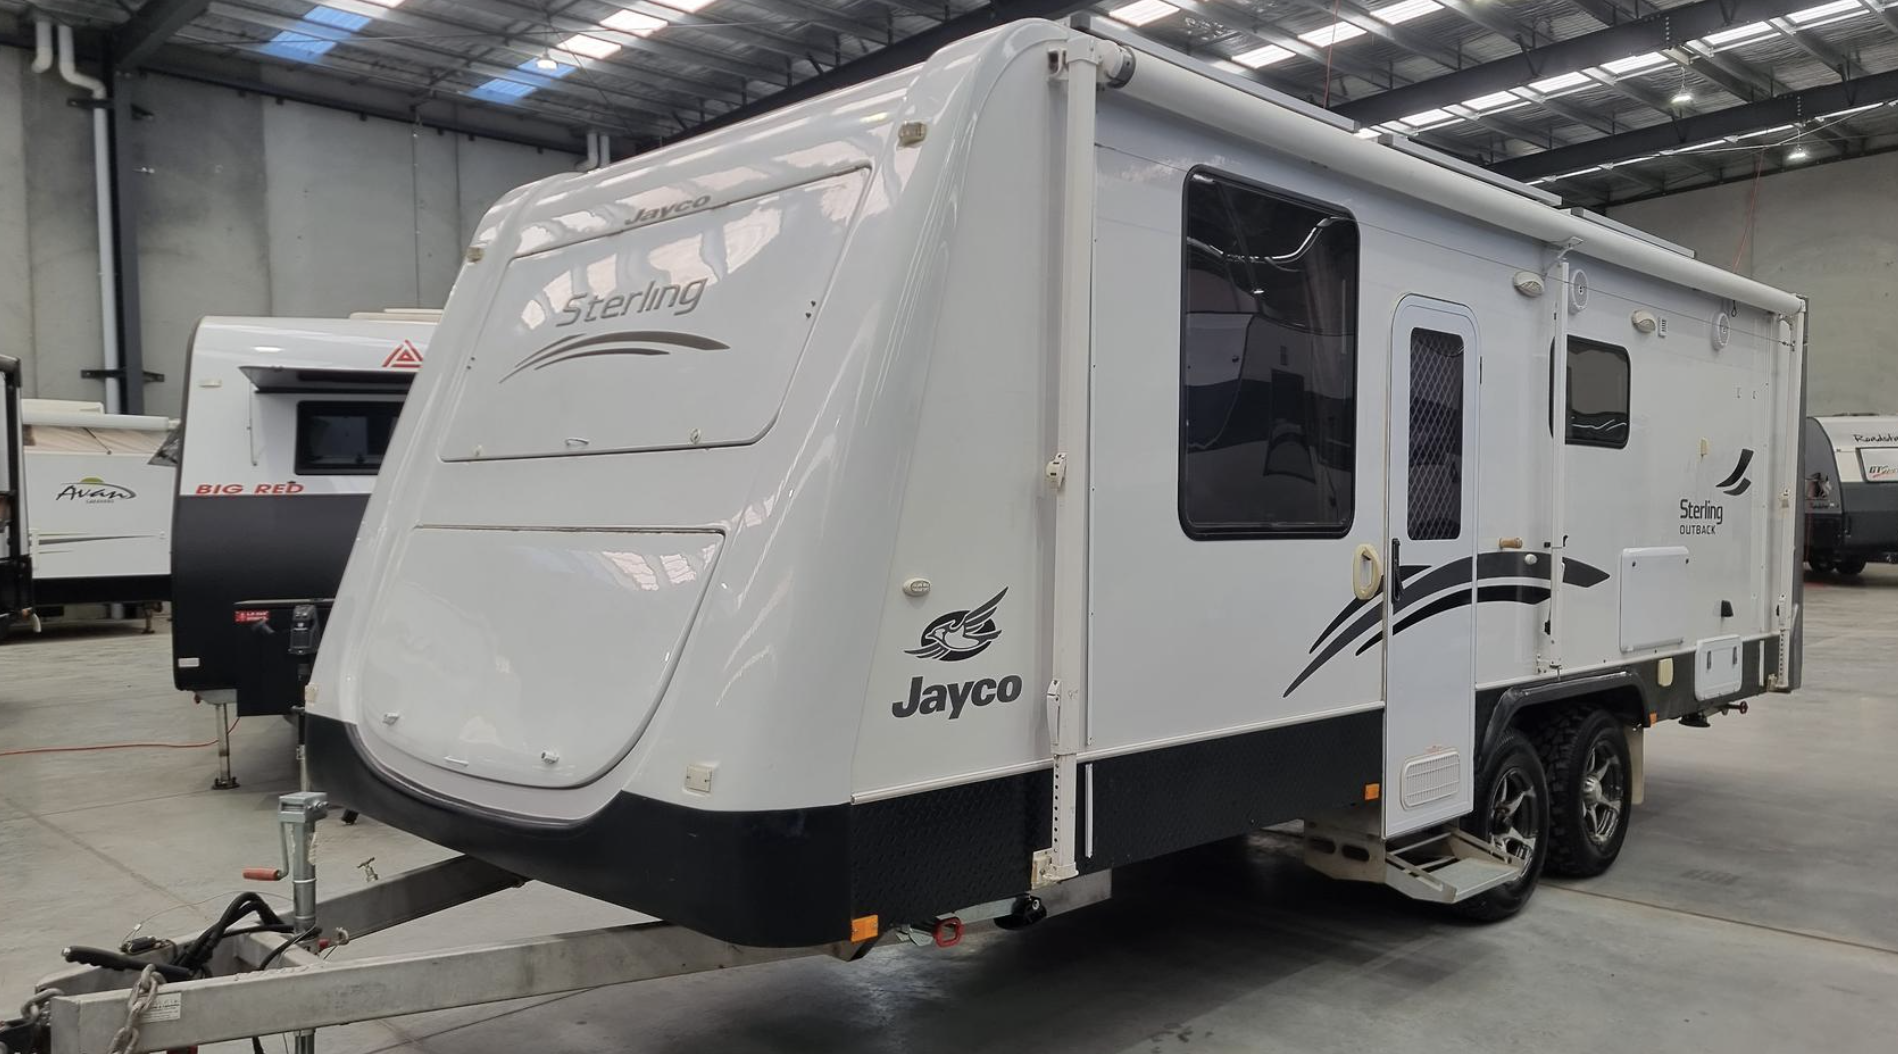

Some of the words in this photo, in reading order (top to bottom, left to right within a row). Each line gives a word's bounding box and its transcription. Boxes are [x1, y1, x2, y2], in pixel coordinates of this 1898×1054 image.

[624, 195, 711, 225] Jayco
[555, 278, 709, 327] Sterling
[56, 484, 130, 501] Avan
[196, 484, 244, 494] BIG
[254, 483, 304, 494] RED
[1680, 499, 1723, 525] Sterling
[1680, 524, 1716, 535] OUTBACK
[892, 675, 1023, 720] Jayco
